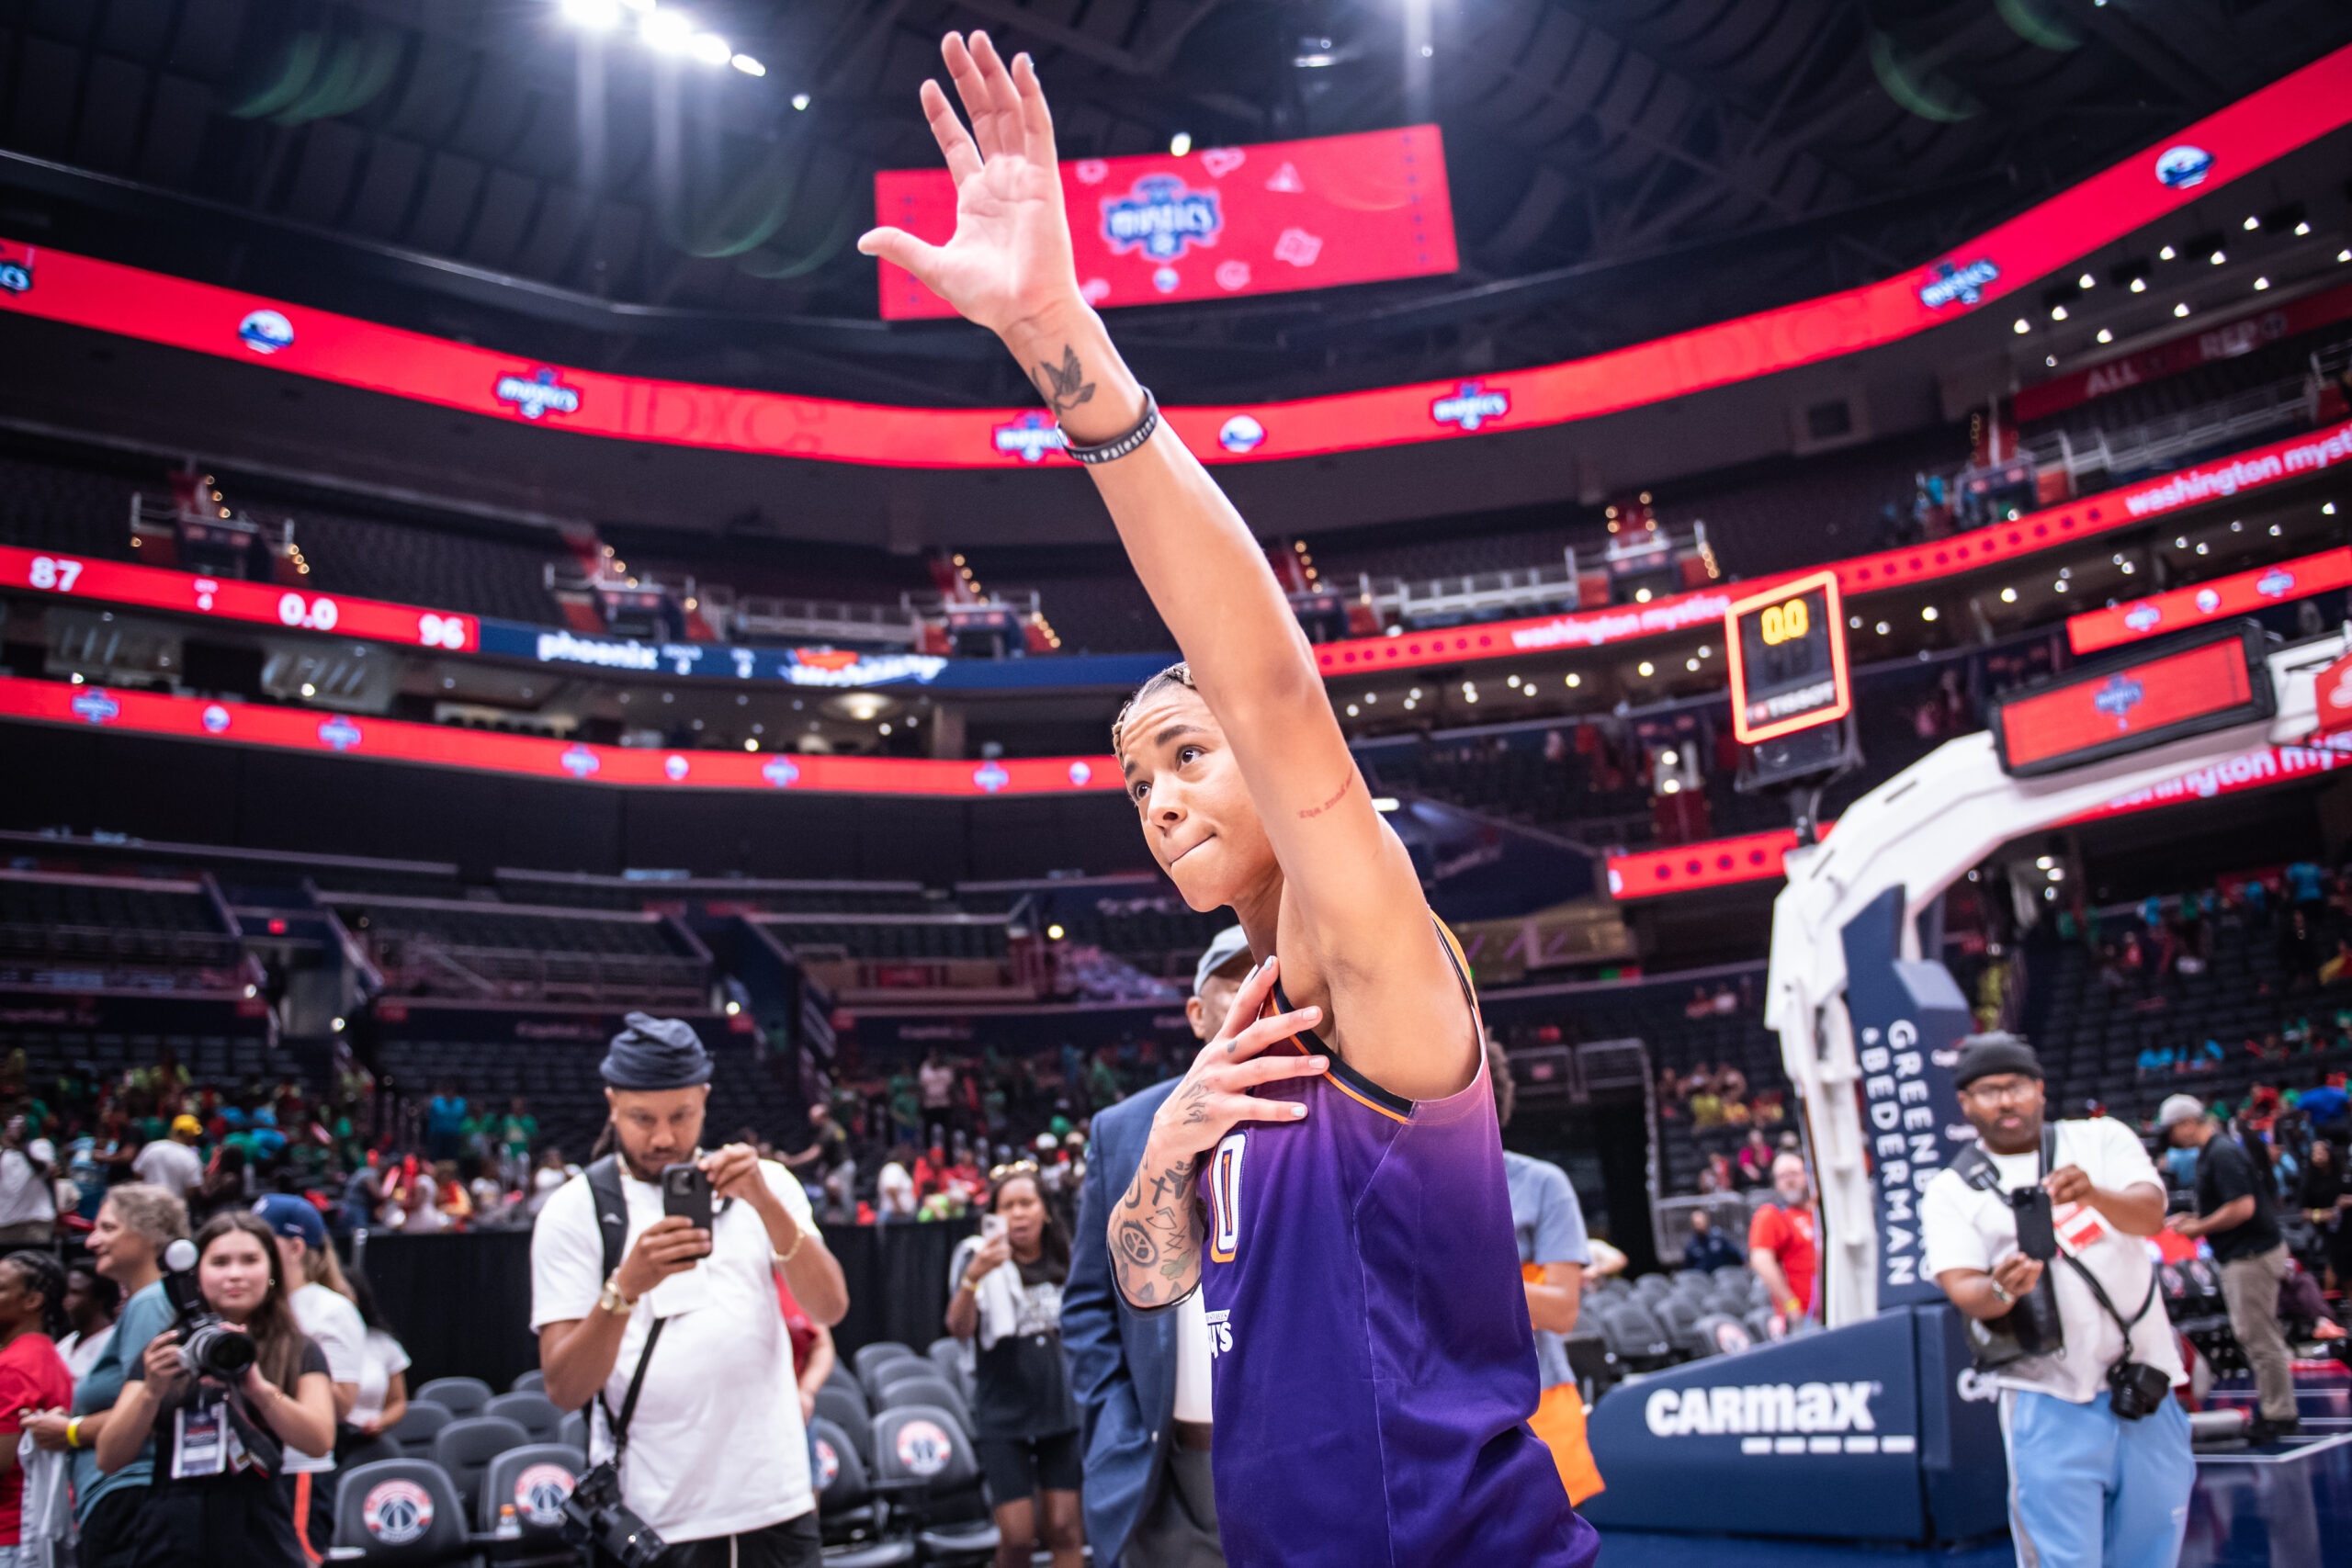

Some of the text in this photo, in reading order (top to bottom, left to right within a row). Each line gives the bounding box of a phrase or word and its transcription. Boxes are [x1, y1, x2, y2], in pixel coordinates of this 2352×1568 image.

[2125, 459, 2282, 516] washington
[28, 557, 83, 592] 87
[277, 593, 338, 632] 0.0
[418, 613, 466, 650] 96
[1860, 1046, 1916, 1285] BEDERMAN
[1887, 1019, 1938, 1282] GREENB
